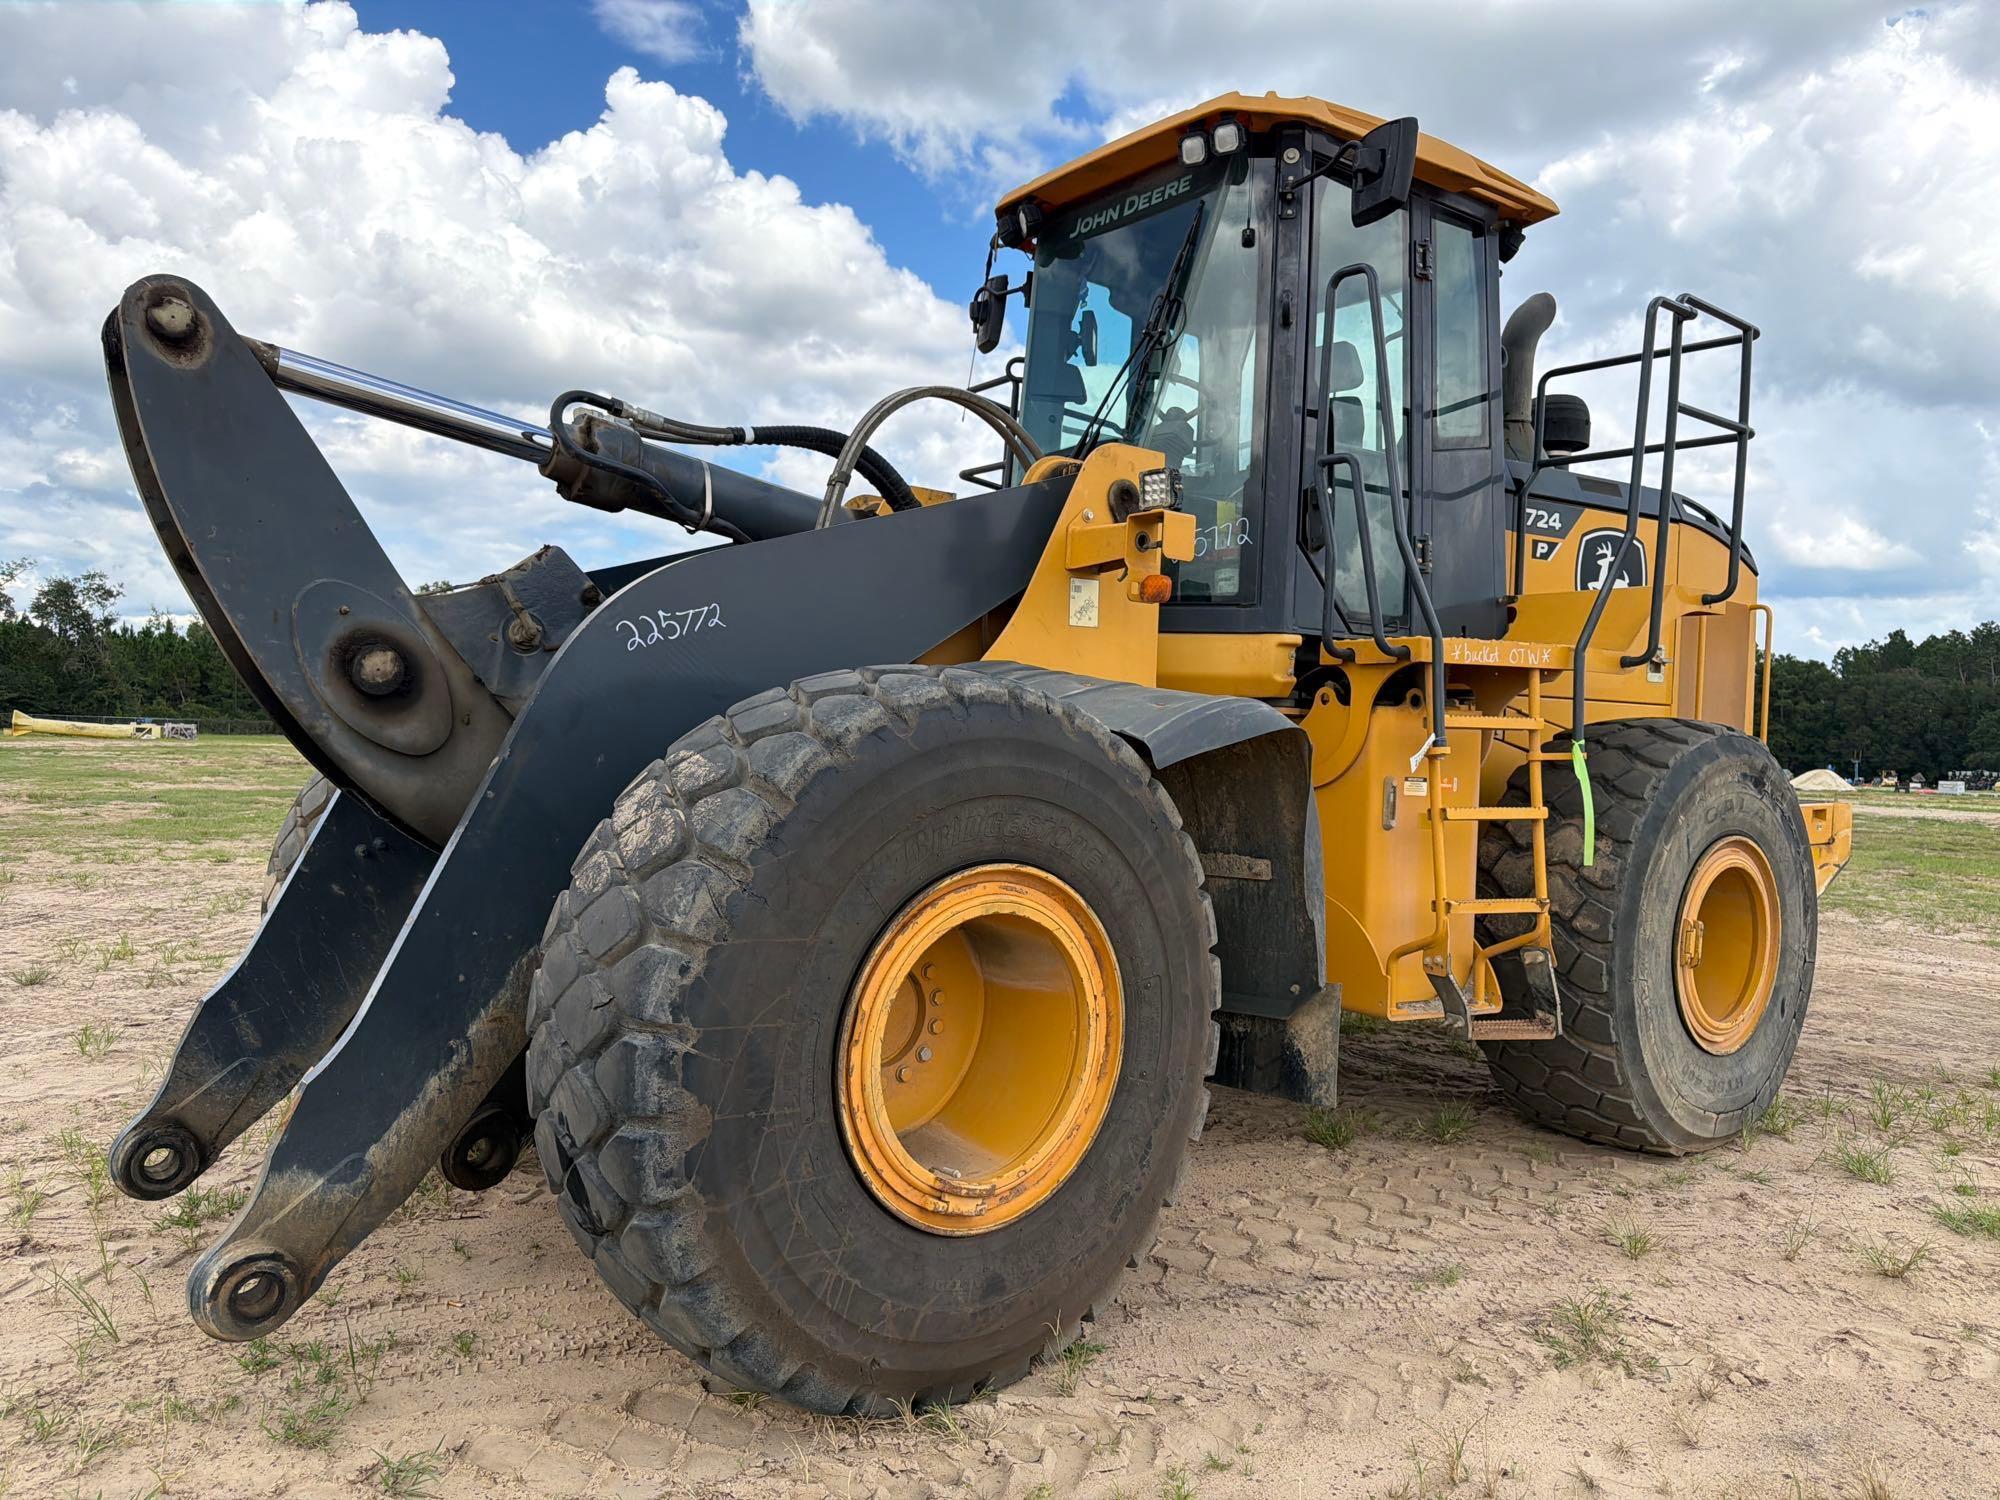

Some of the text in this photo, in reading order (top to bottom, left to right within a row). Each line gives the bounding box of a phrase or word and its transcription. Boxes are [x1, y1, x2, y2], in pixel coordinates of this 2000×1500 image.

[1069, 174, 1193, 239] JOHN DEERE
[1172, 517, 1253, 564] 5772
[1525, 507, 1562, 531] 724
[1535, 542, 1549, 558] P
[615, 603, 727, 651] 225772
